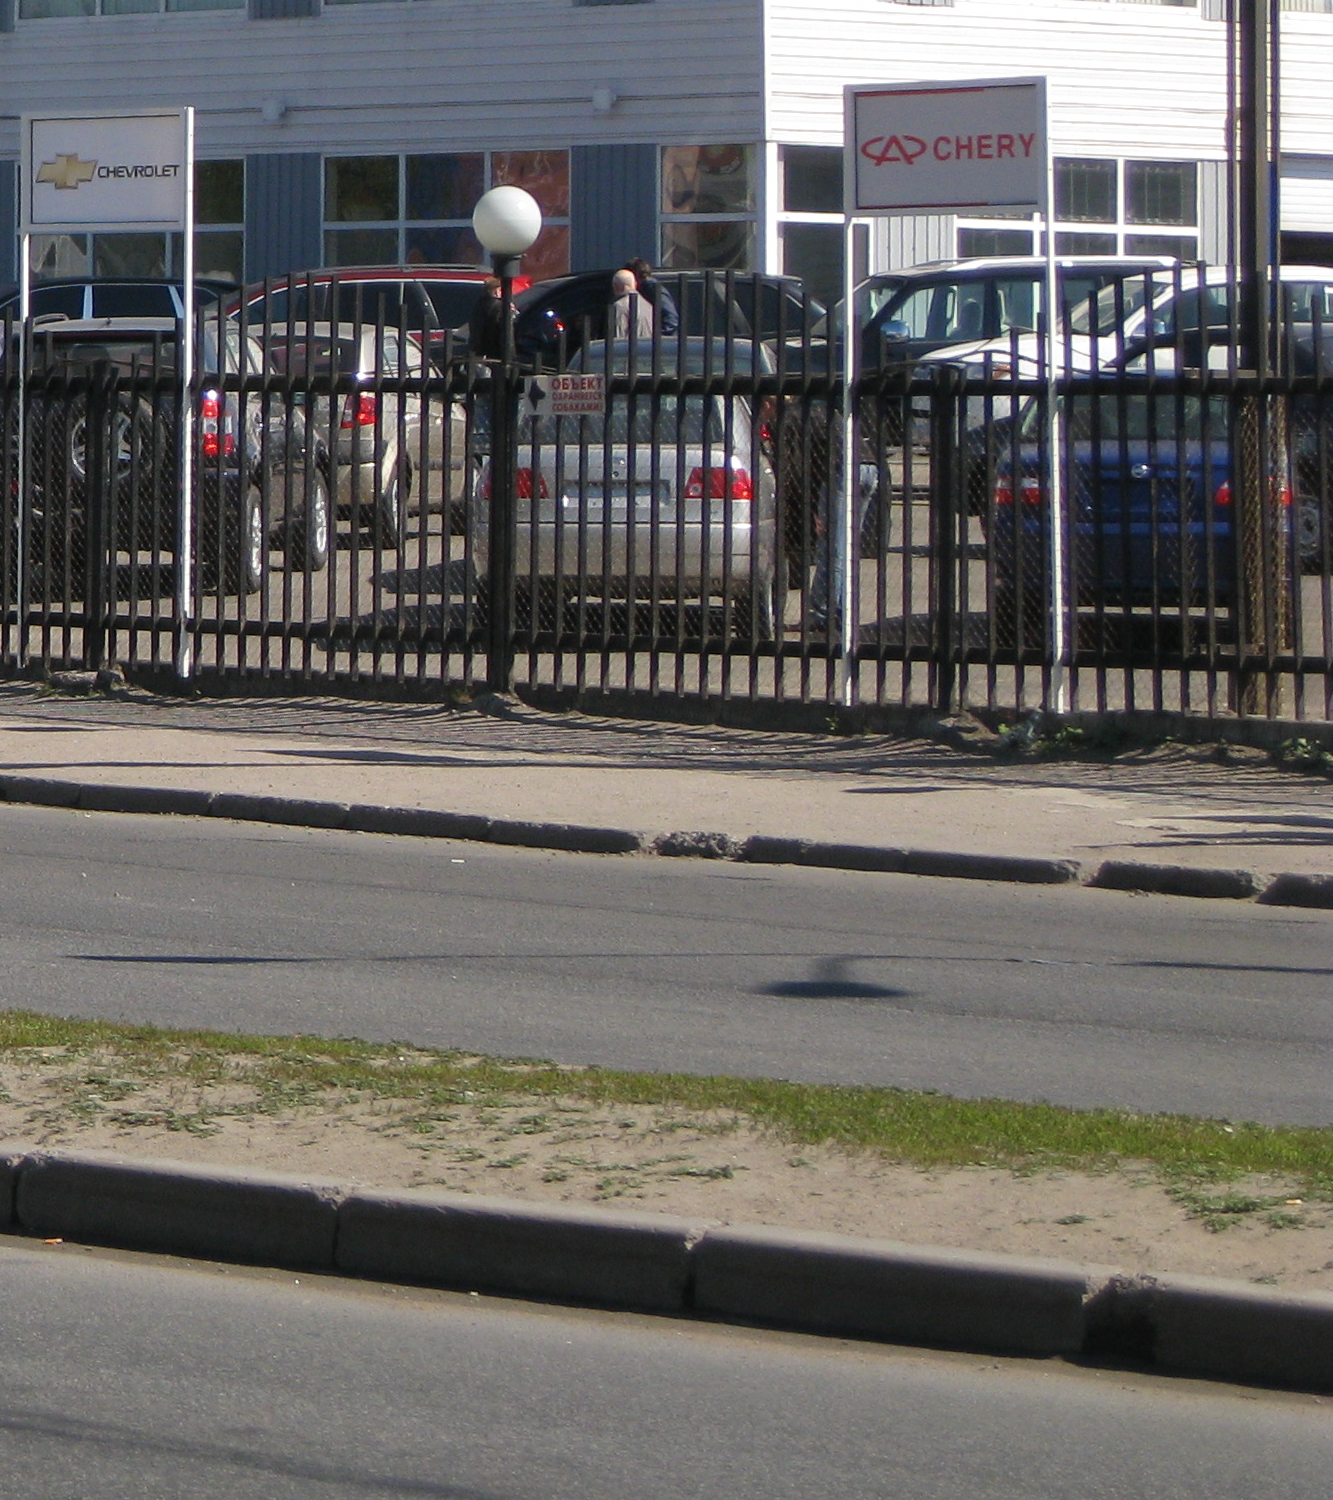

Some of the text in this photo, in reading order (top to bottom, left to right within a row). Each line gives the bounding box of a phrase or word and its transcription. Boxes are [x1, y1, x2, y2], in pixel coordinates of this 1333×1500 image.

[933, 133, 1035, 161] CHERY
[97, 164, 180, 179] CHEVROLET
[552, 378, 603, 390] ОБЪЕКТ
